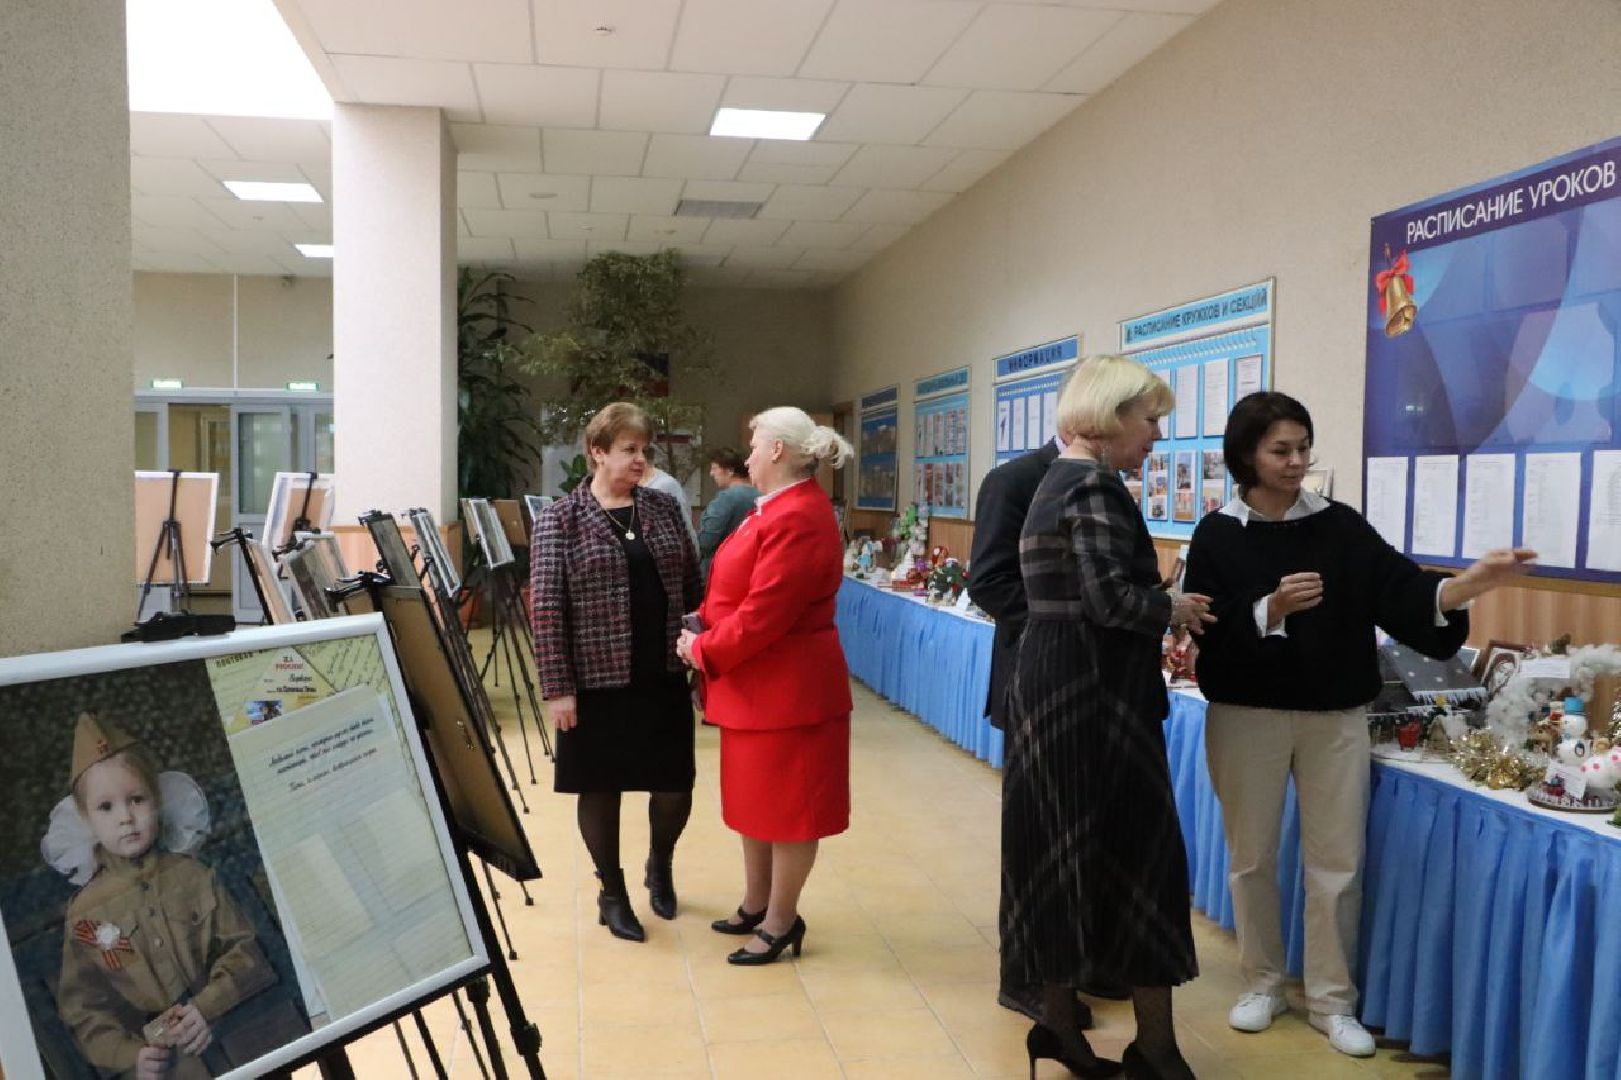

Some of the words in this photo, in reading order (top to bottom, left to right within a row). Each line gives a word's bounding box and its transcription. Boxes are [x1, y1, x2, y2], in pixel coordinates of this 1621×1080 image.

[1407, 188, 1524, 245] РАСПИСАНИЕ
[1528, 161, 1617, 209] УРОКОВ
[1134, 314, 1181, 337] РАСПИСАНИЕ
[1181, 301, 1221, 326] КРУЖКОВ
[1222, 301, 1229, 316] И
[1230, 287, 1268, 314] СЕКЦИЙ
